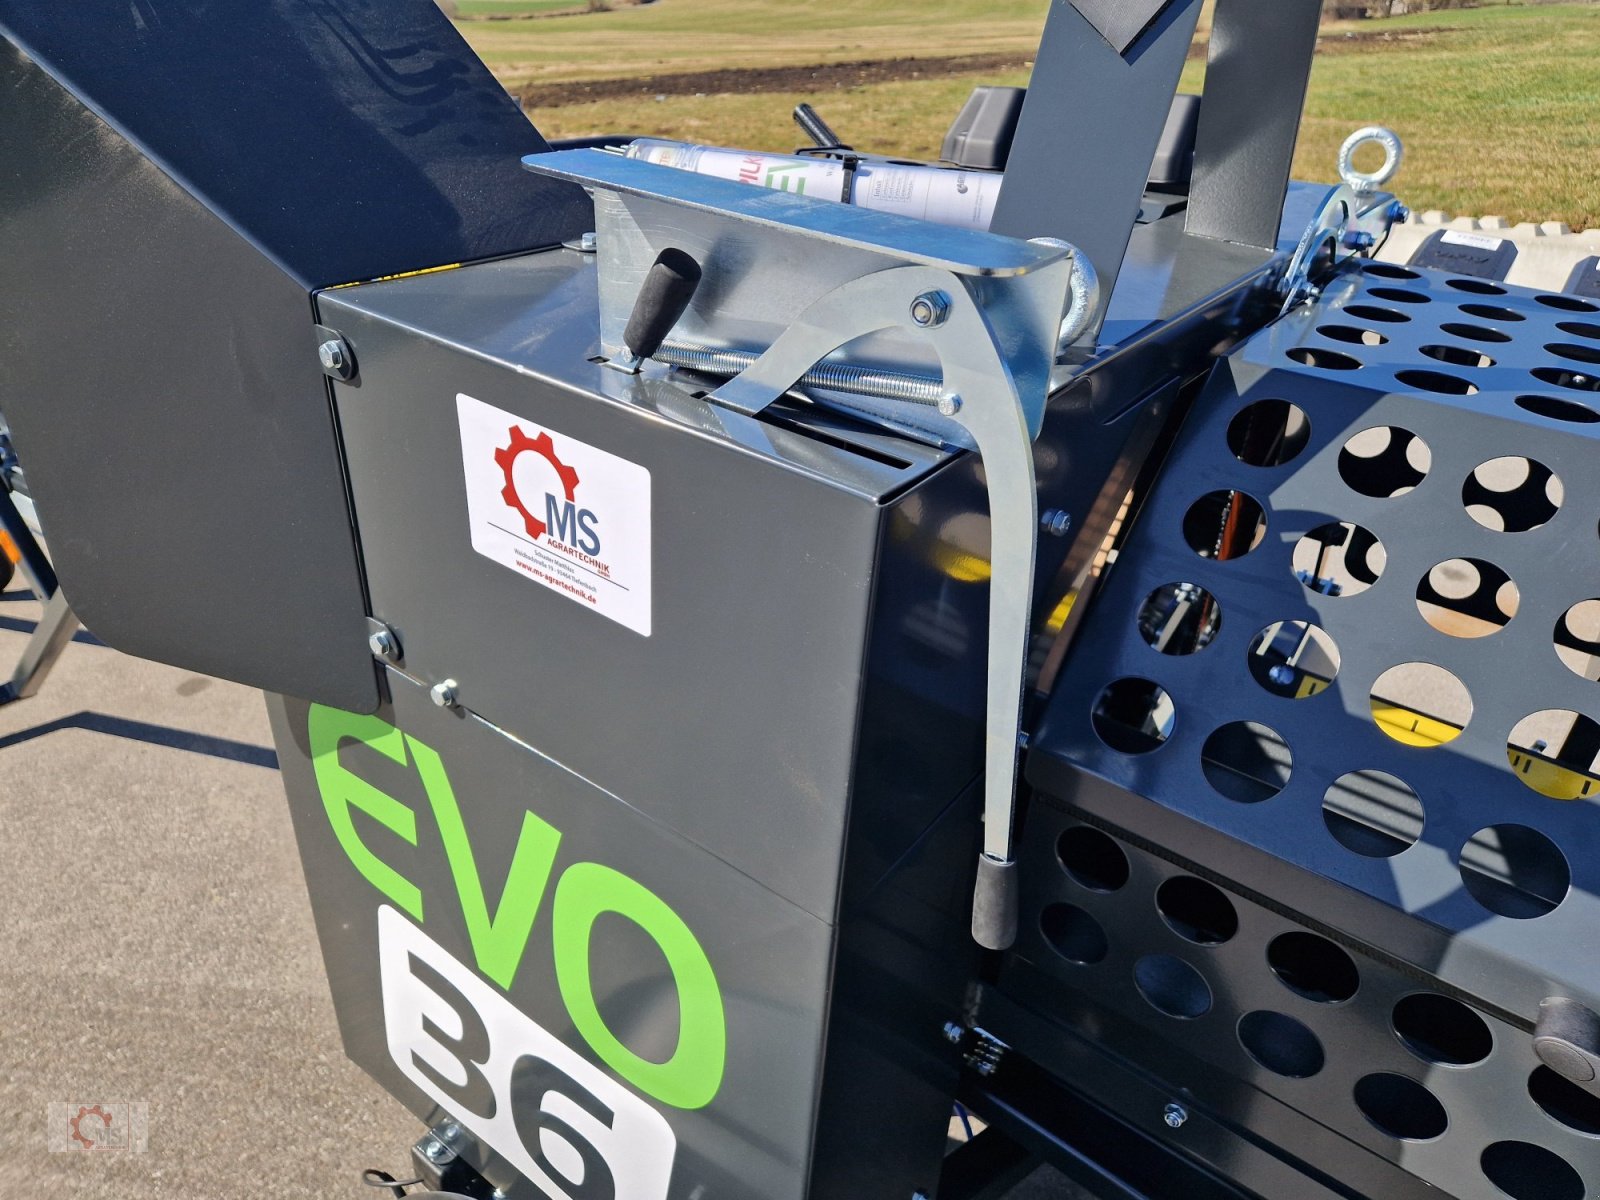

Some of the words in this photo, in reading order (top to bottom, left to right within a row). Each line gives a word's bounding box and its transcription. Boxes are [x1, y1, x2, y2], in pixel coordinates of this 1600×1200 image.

[545, 492, 600, 556] MS
[547, 538, 610, 573] AGRARTECHNIK
[516, 560, 597, 604] www.ms-agrartechnik.de
[308, 703, 726, 1109] EVO
[407, 949, 616, 1200] 36
